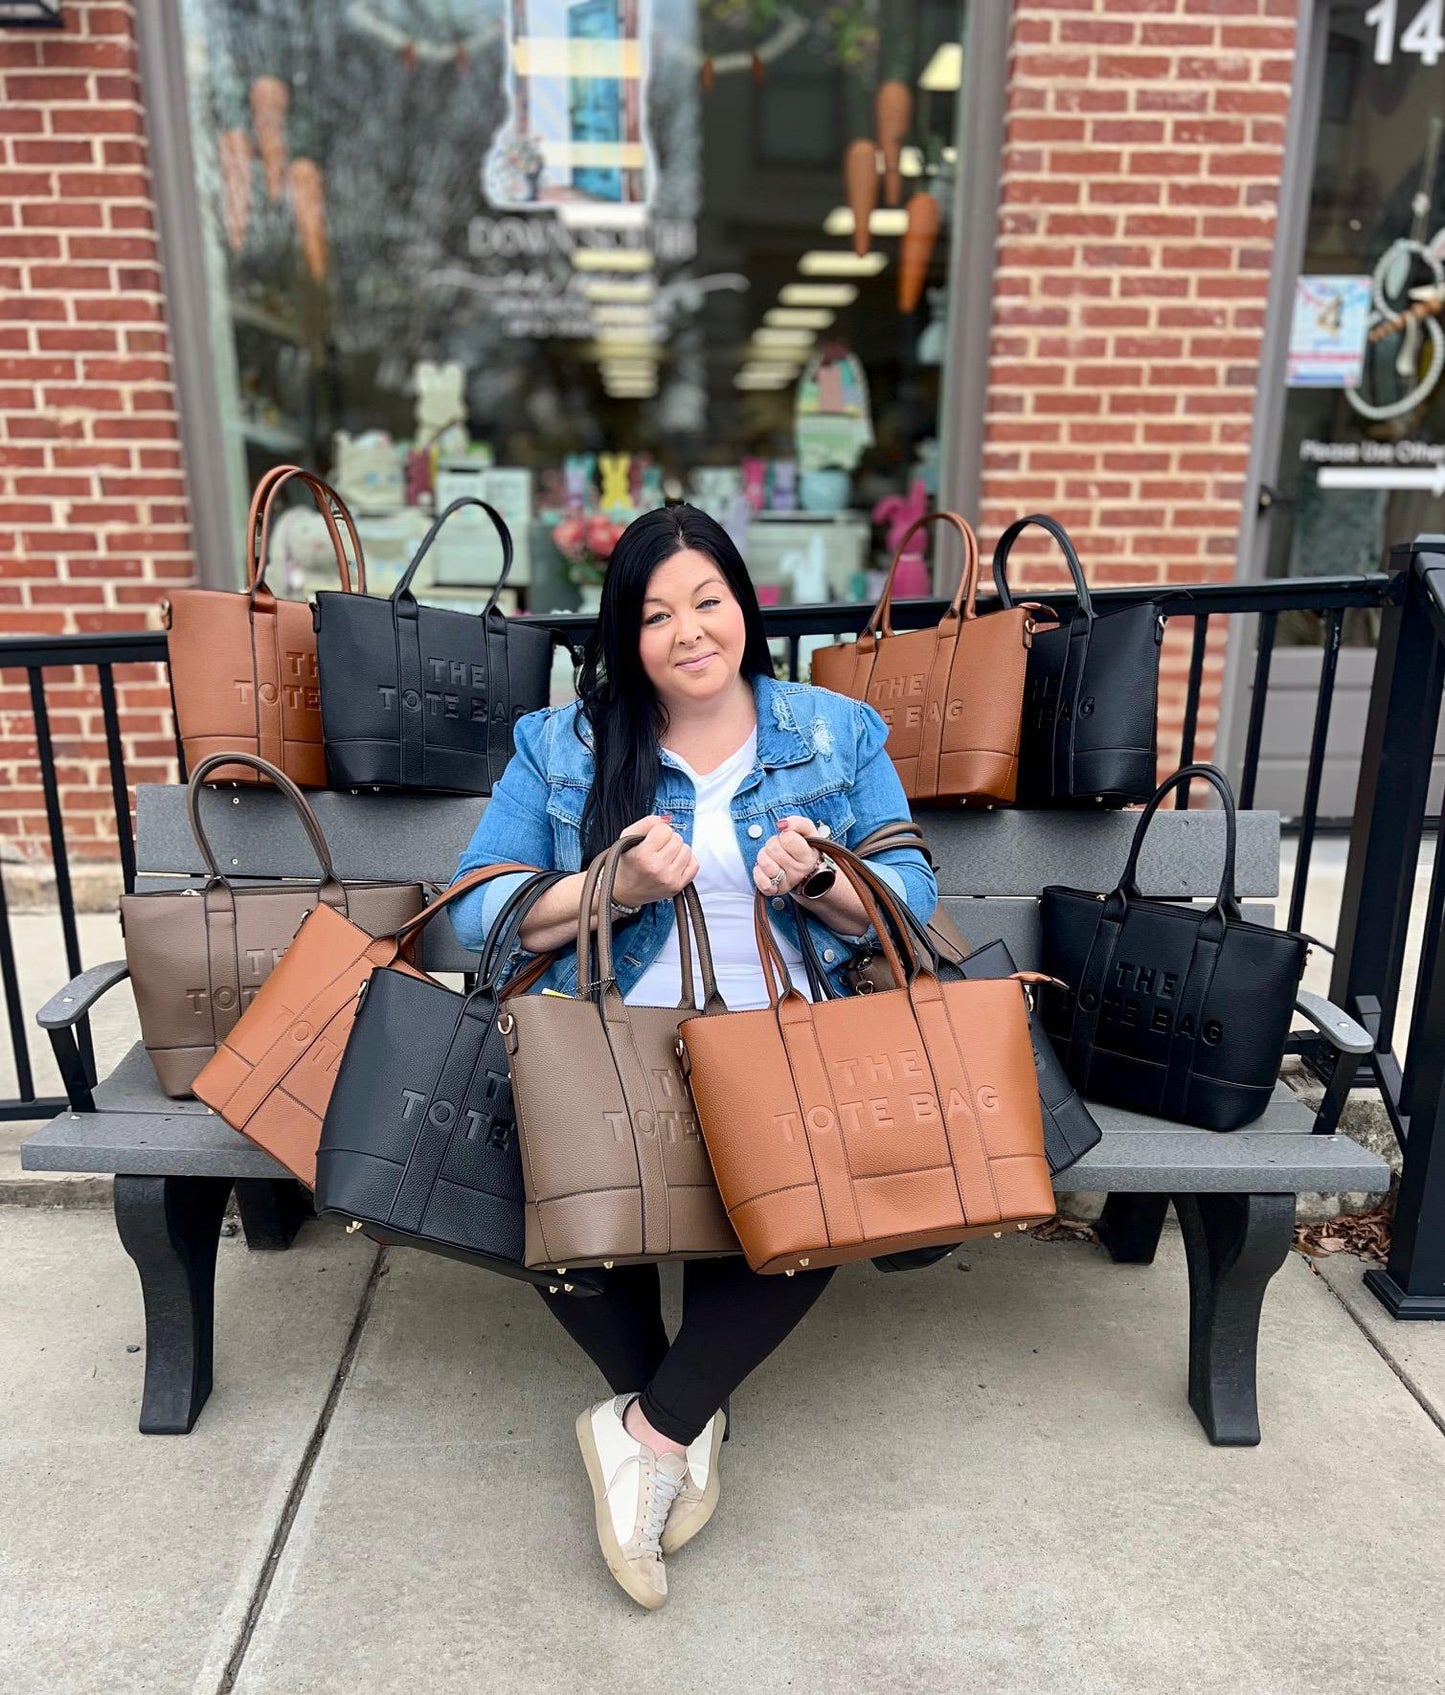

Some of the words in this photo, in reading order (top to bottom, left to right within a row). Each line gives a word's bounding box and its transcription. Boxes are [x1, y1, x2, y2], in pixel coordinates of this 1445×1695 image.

[1364, 0, 1445, 66] 14
[1300, 439, 1359, 462] Please
[1361, 440, 1394, 462] Use
[428, 657, 486, 689] THE
[872, 673, 926, 701] THE
[233, 679, 321, 711] TOTE
[377, 684, 460, 719] TOTE
[905, 698, 964, 728] BAG
[1115, 961, 1180, 1001] THE
[1149, 1004, 1225, 1048] BAG
[834, 1049, 924, 1088] THE
[602, 1109, 701, 1142] TOTE
[773, 1096, 895, 1143] TOTE
[908, 1084, 1000, 1123] BAG
